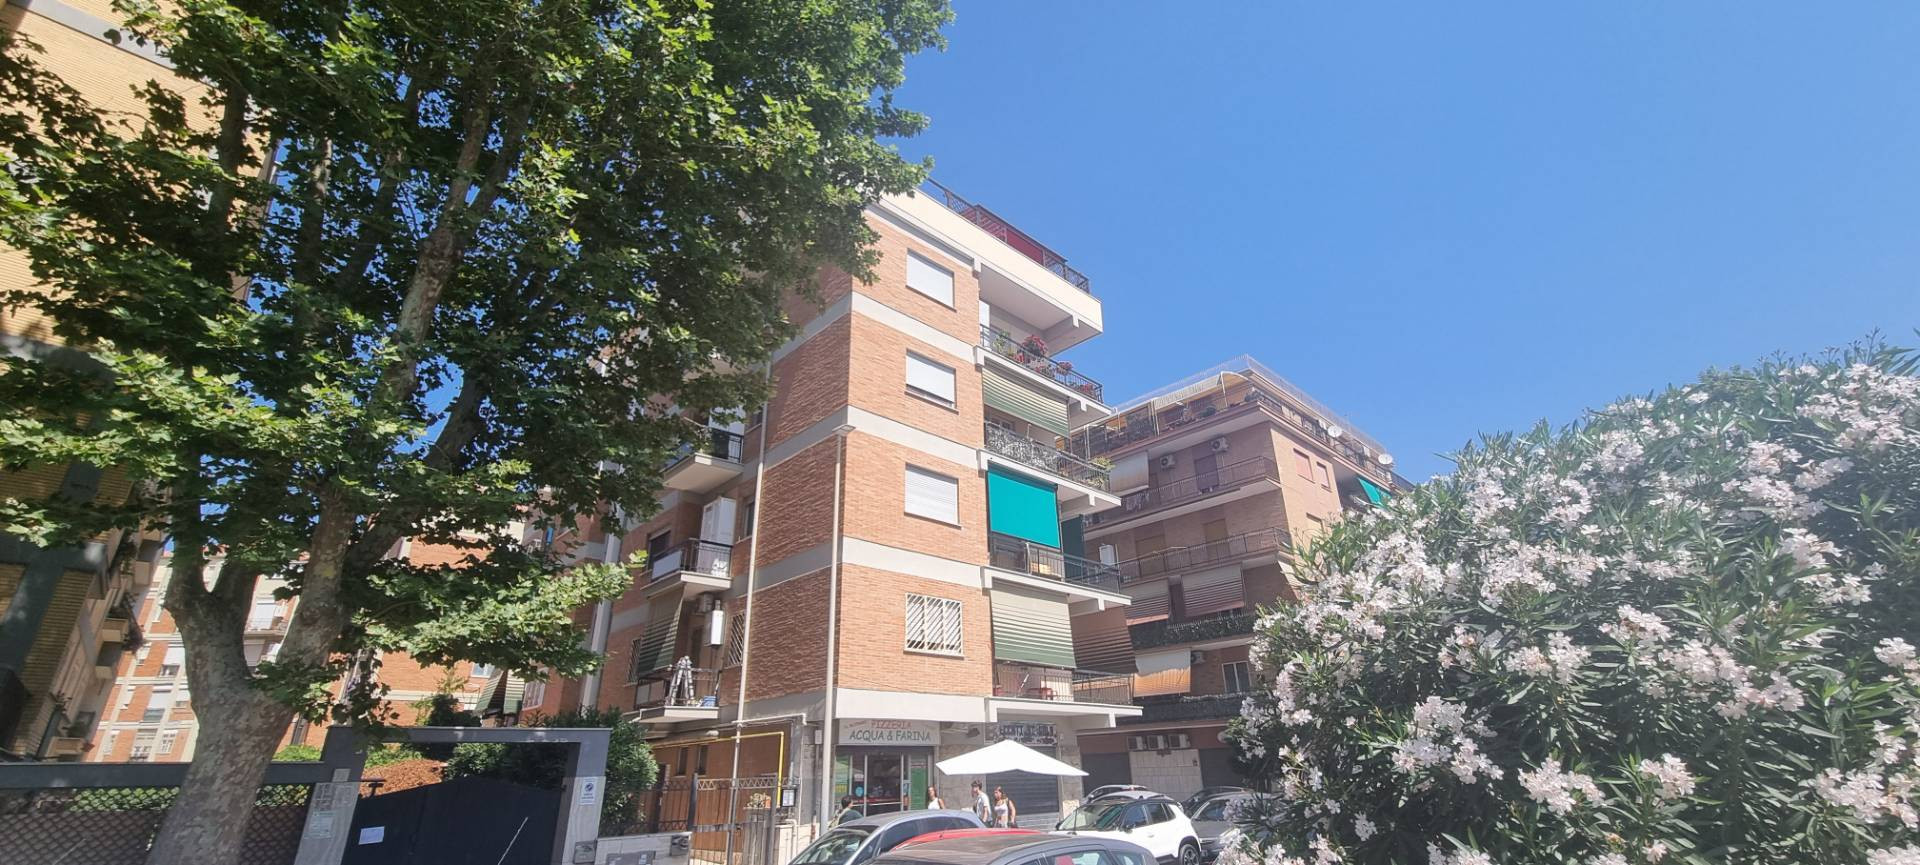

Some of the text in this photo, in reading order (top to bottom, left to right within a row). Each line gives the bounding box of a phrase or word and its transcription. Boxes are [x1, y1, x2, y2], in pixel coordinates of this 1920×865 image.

[871, 720, 912, 730] PIZZERIA
[849, 730, 931, 742] ACQUA & FARINA
